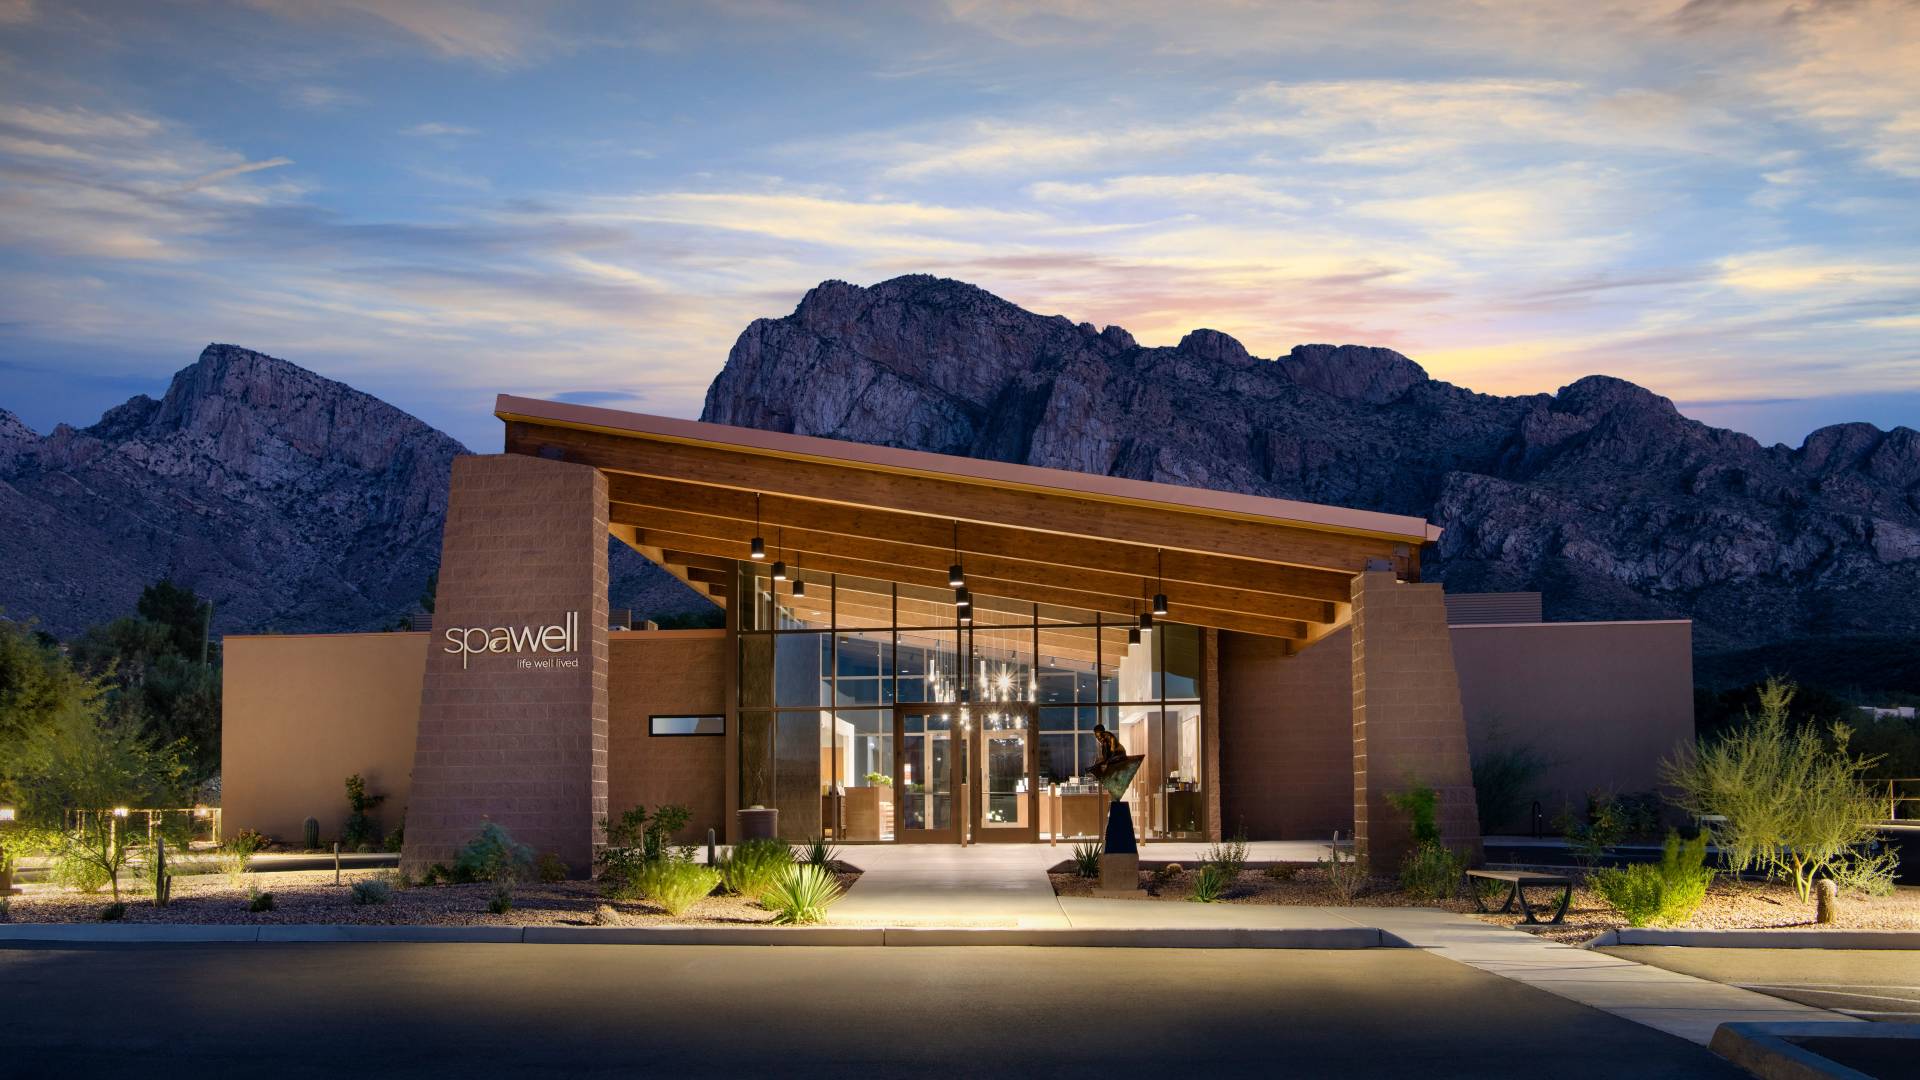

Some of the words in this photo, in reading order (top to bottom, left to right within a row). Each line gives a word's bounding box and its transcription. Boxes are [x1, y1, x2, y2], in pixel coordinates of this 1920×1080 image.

[444, 611, 578, 669] spawell
[516, 658, 532, 669] life
[533, 658, 553, 669] well
[555, 657, 579, 668] lived
